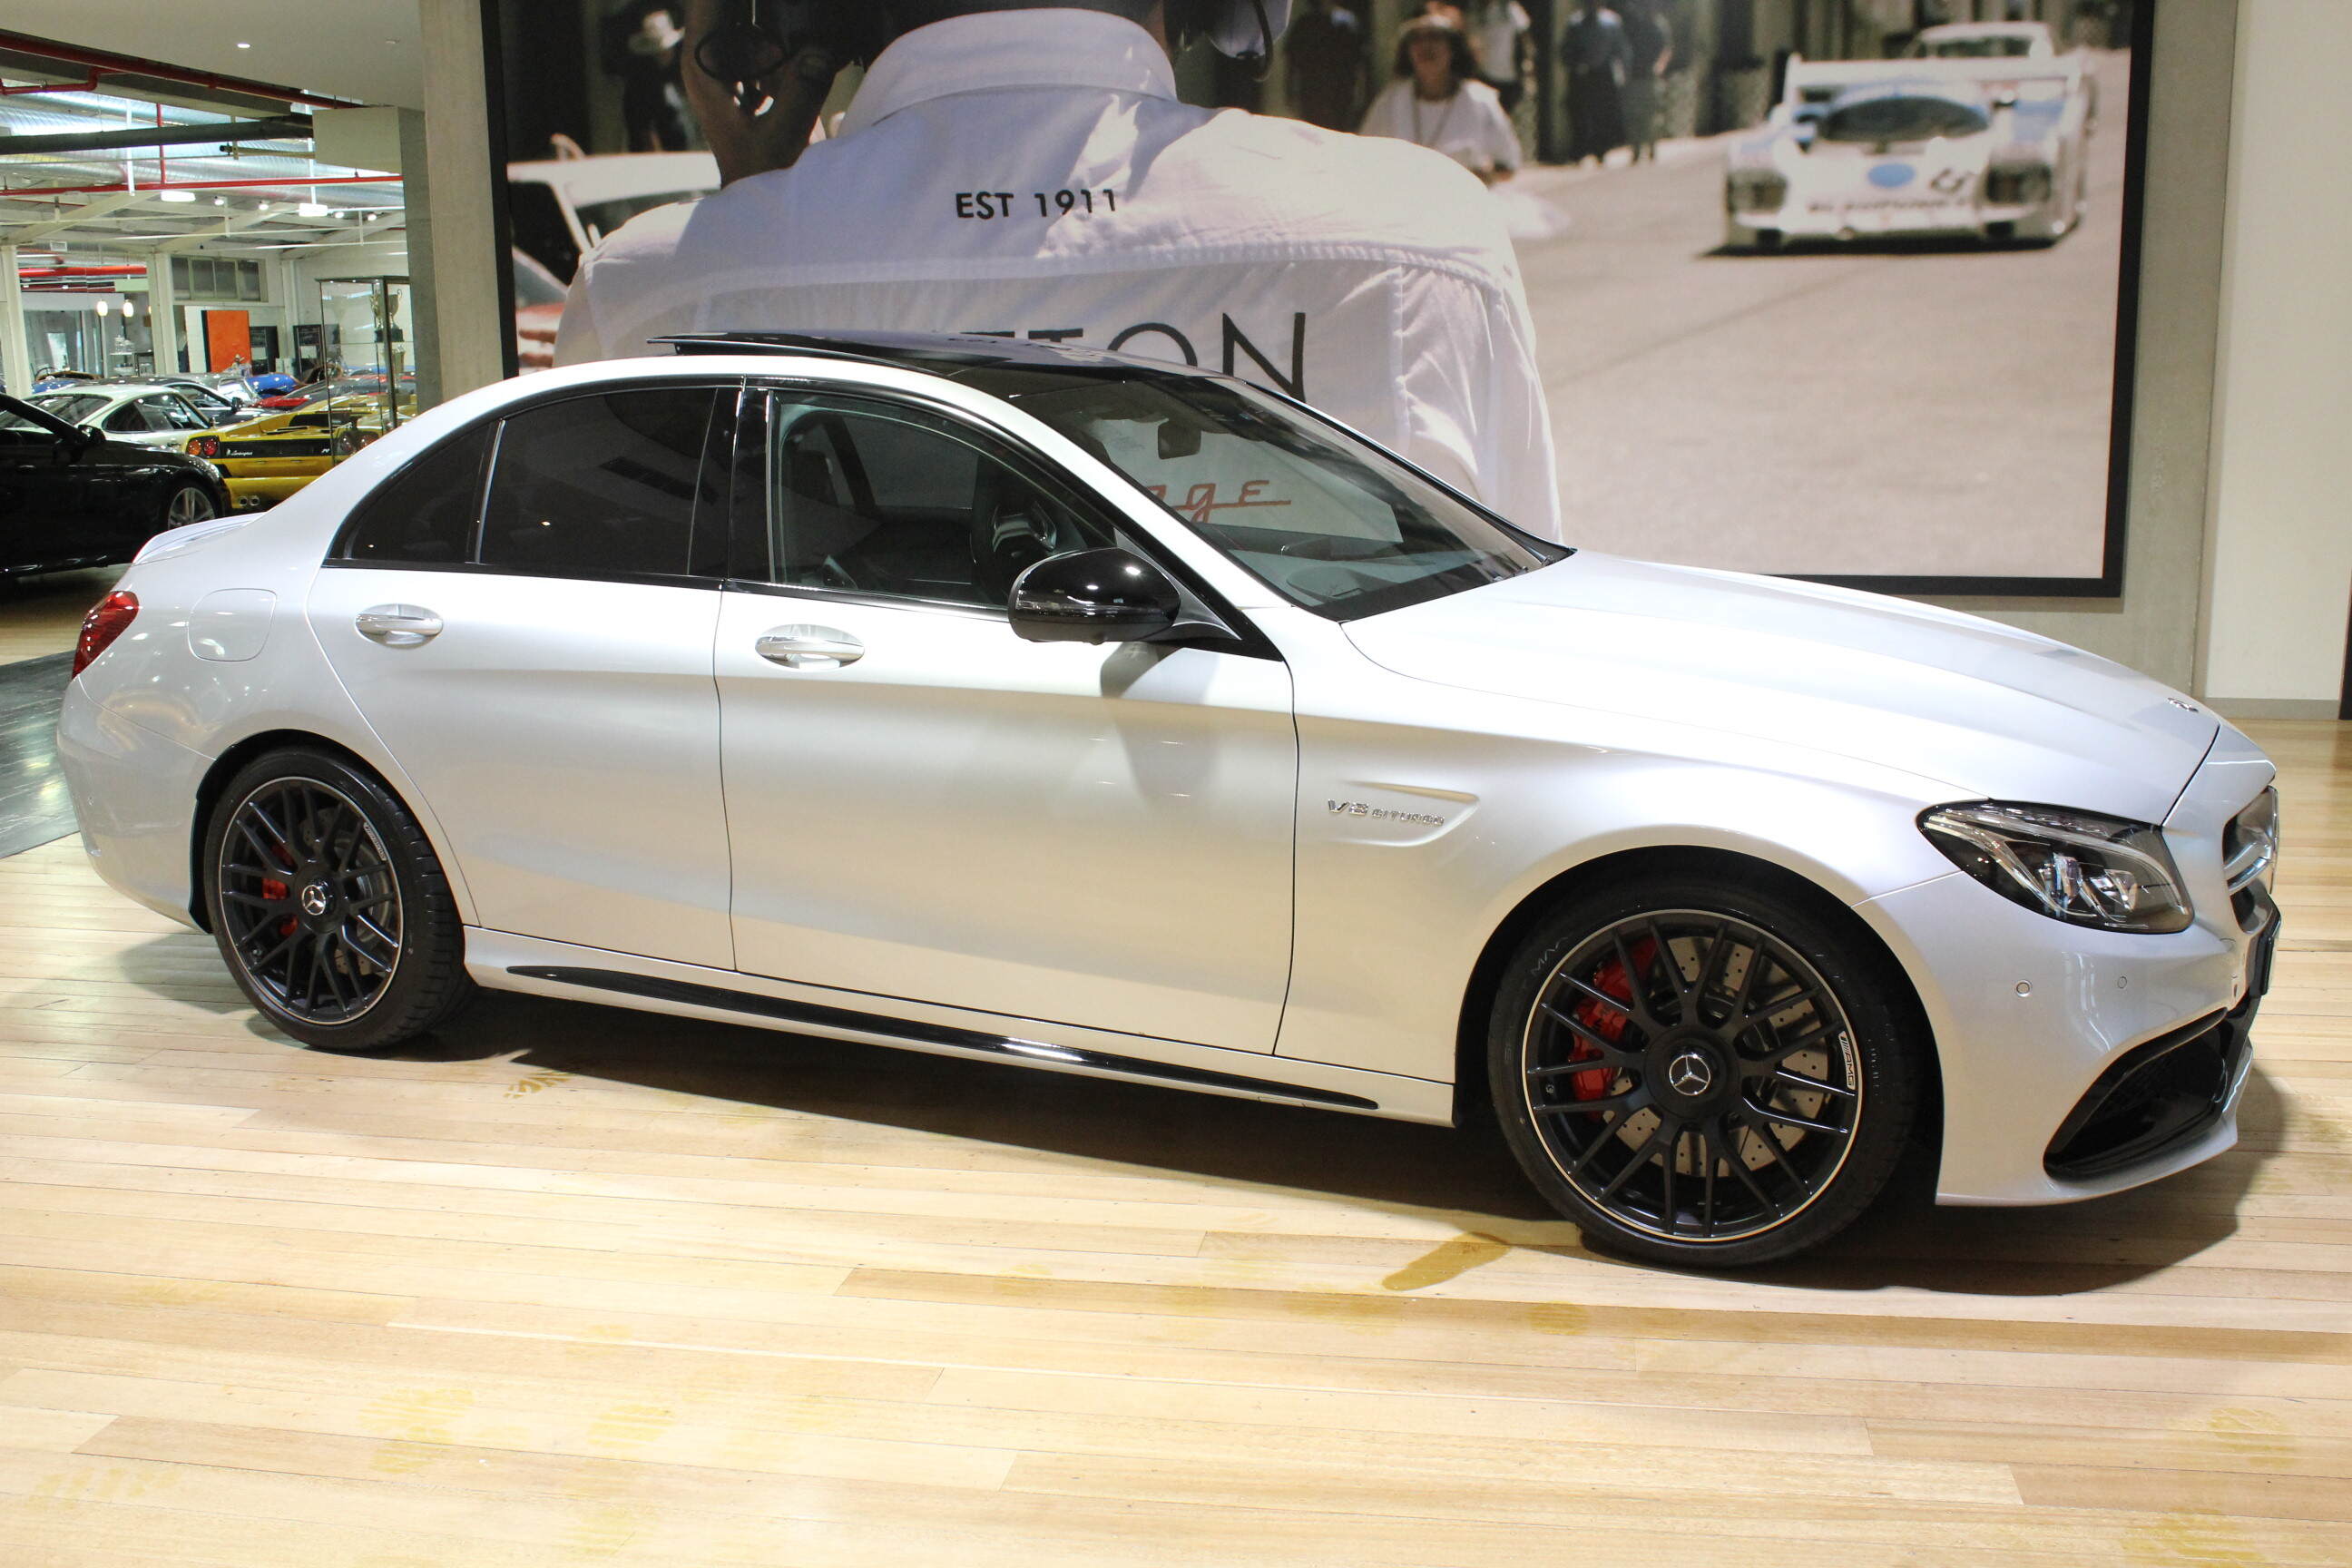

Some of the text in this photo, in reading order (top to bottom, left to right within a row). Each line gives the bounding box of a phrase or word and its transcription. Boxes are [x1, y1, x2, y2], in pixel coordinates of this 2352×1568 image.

[956, 189, 1116, 220] EST 1911
[1328, 799, 1368, 817] V8
